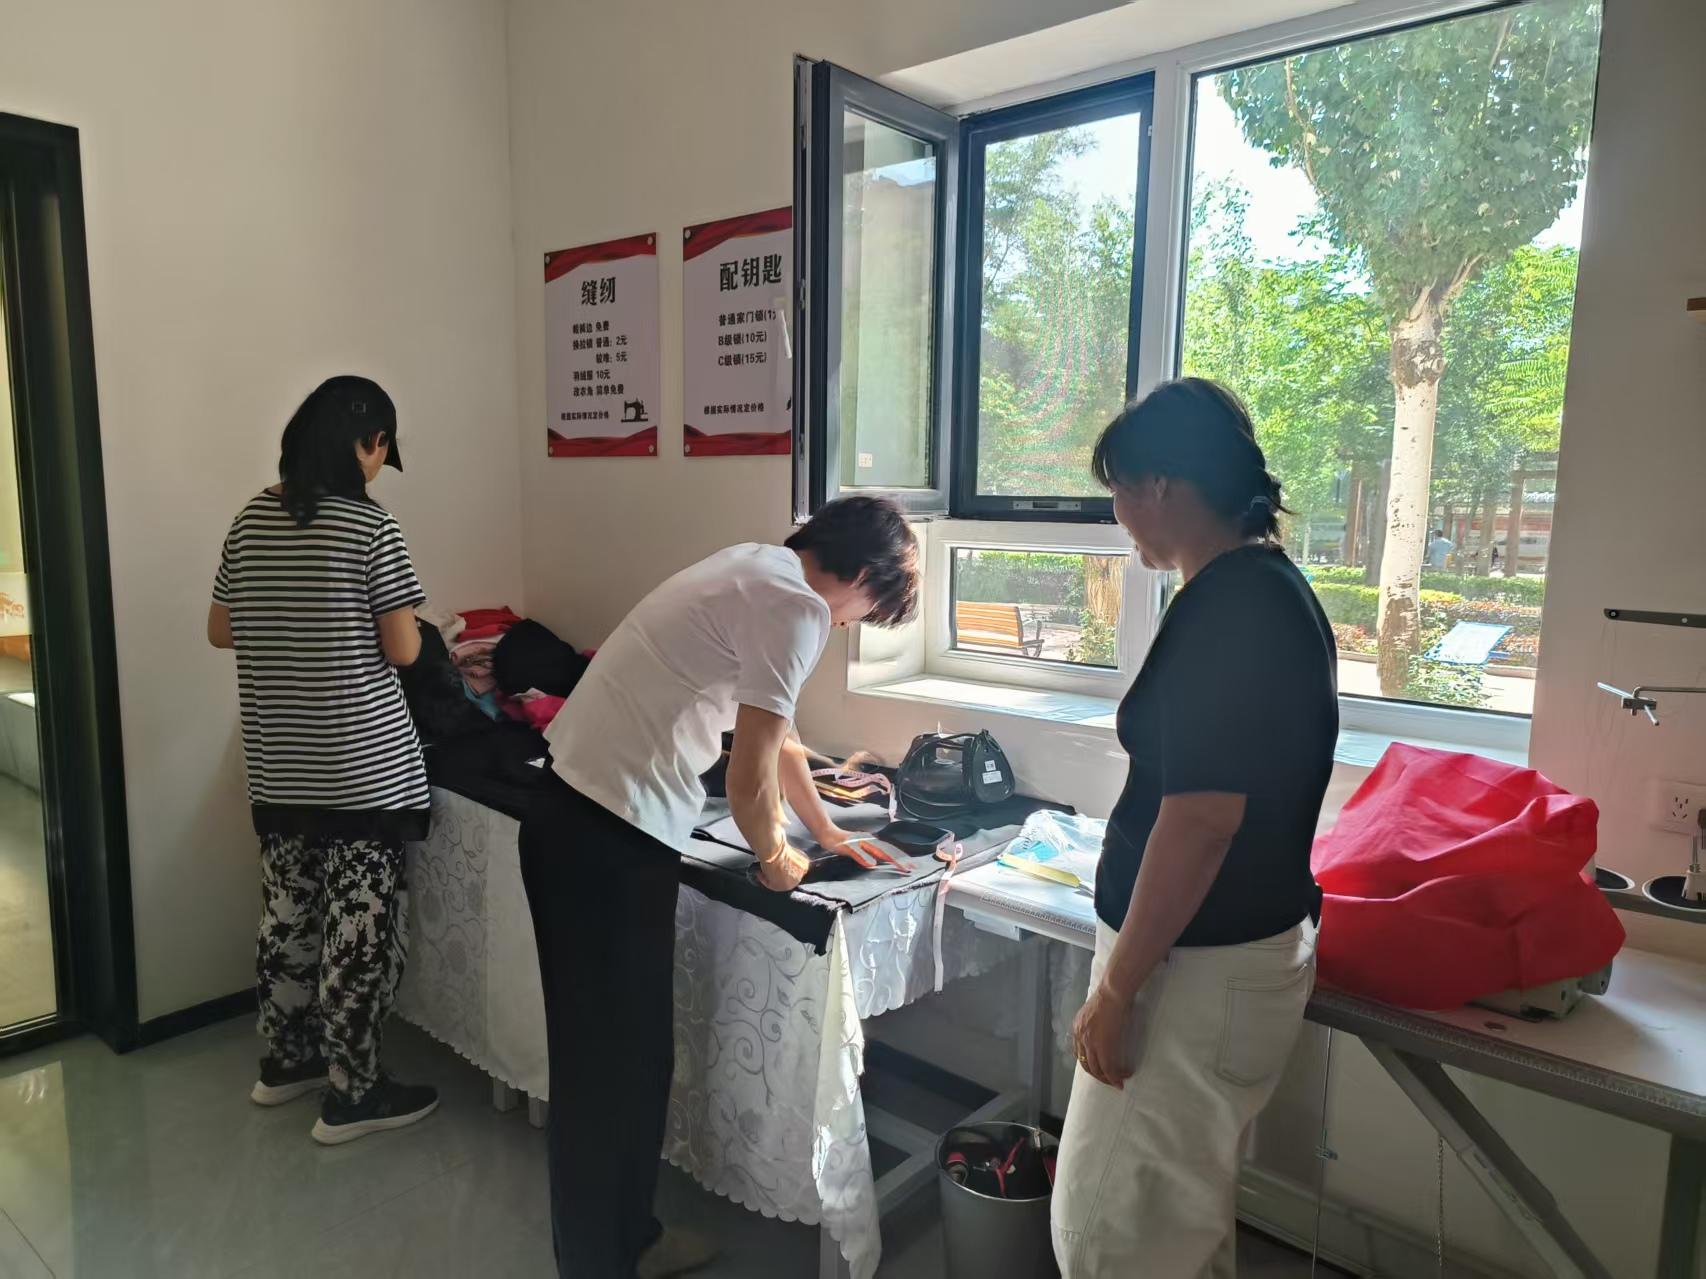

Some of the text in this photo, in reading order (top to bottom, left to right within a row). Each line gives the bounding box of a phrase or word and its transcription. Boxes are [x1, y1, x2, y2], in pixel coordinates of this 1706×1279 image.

[720, 254, 782, 291] 配钥匙
[581, 277, 616, 305] 缝纫
